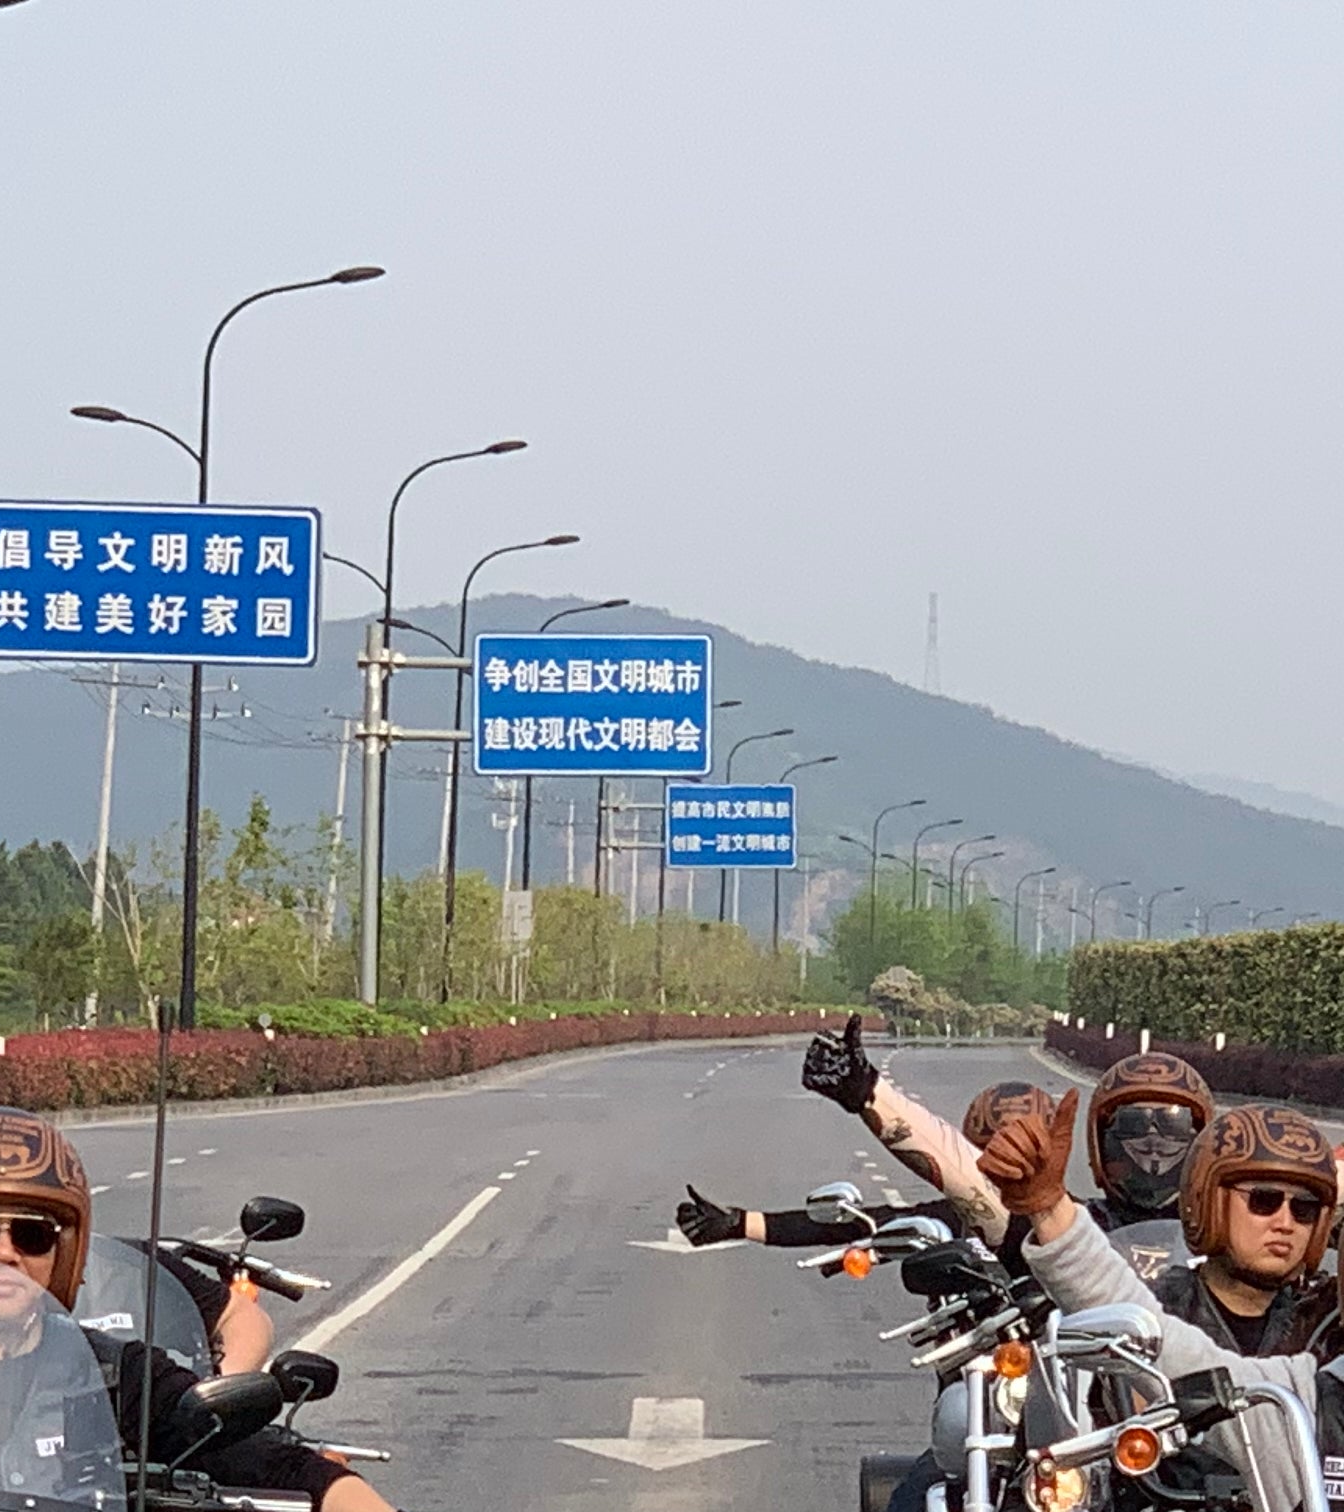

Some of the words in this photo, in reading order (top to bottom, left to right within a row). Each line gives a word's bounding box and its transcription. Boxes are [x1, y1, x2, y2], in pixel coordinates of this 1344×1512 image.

[484, 657, 702, 694] 争创全国文明城市
[484, 716, 702, 752] 建设现代文明都会
